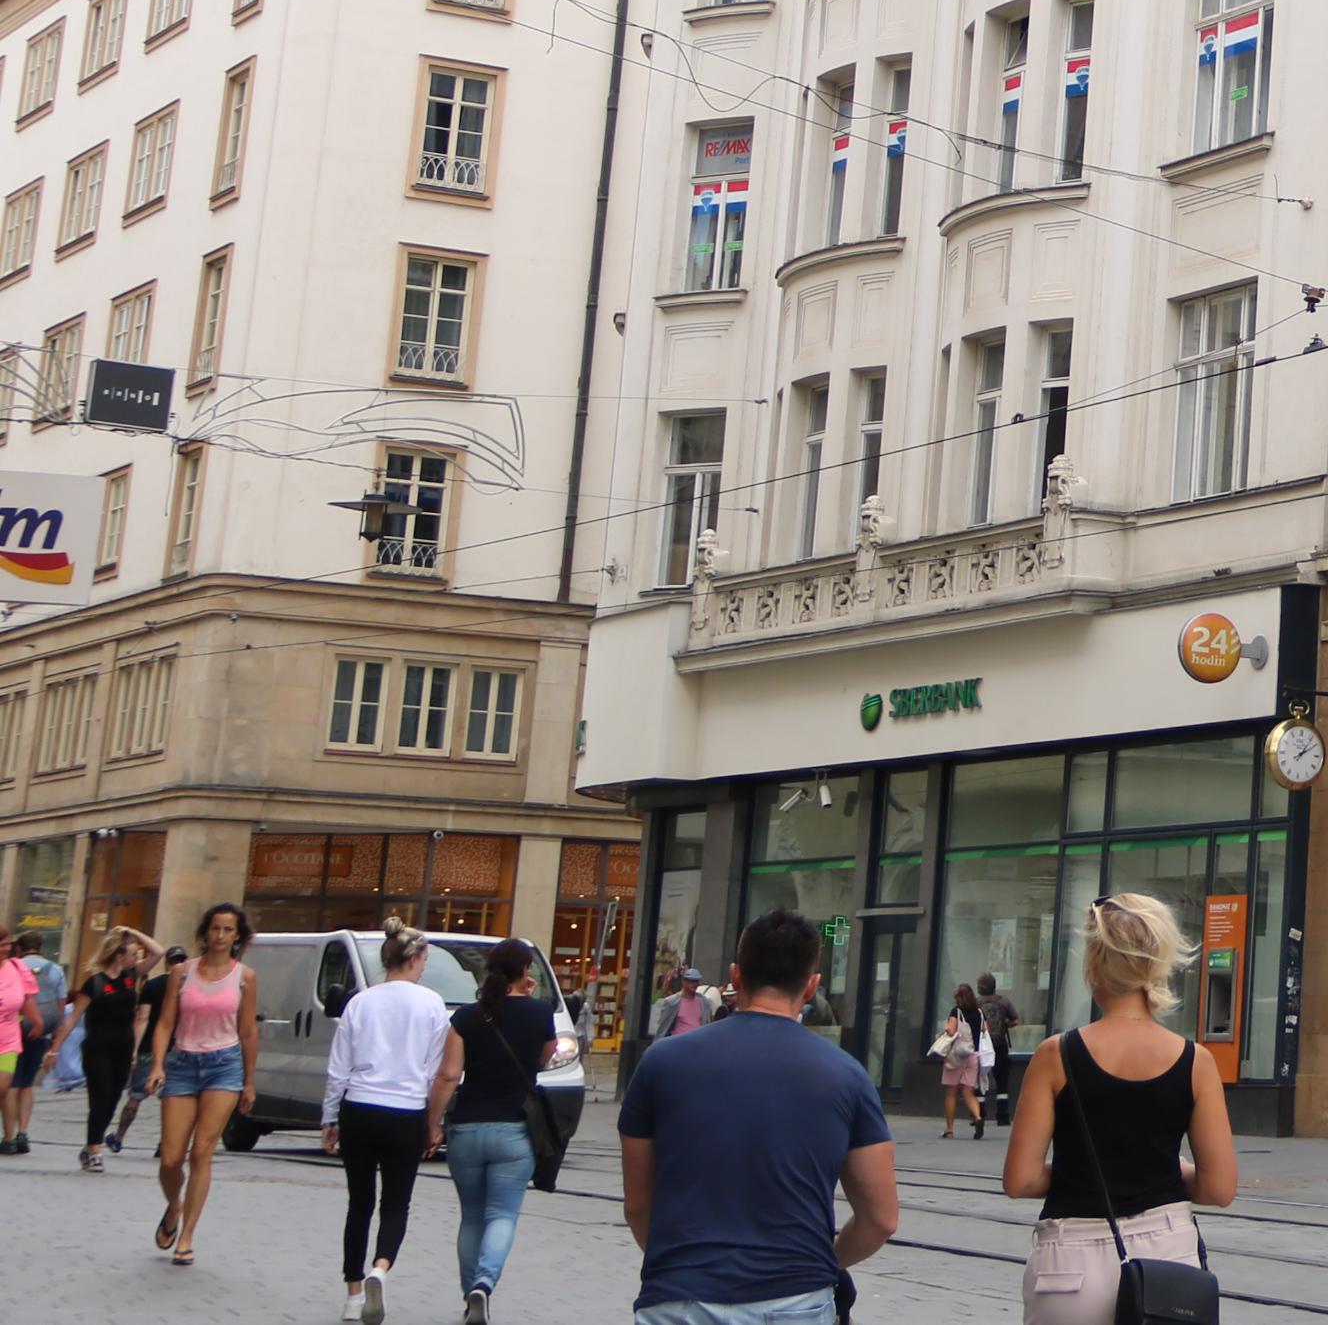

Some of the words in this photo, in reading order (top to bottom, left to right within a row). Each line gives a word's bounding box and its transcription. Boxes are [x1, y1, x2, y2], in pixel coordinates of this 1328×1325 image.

[704, 138, 751, 157] RE/MAX
[0, 487, 63, 550] m
[1191, 626, 1228, 654] 24
[1191, 653, 1226, 667] hodin
[888, 677, 983, 717] SBERBANK
